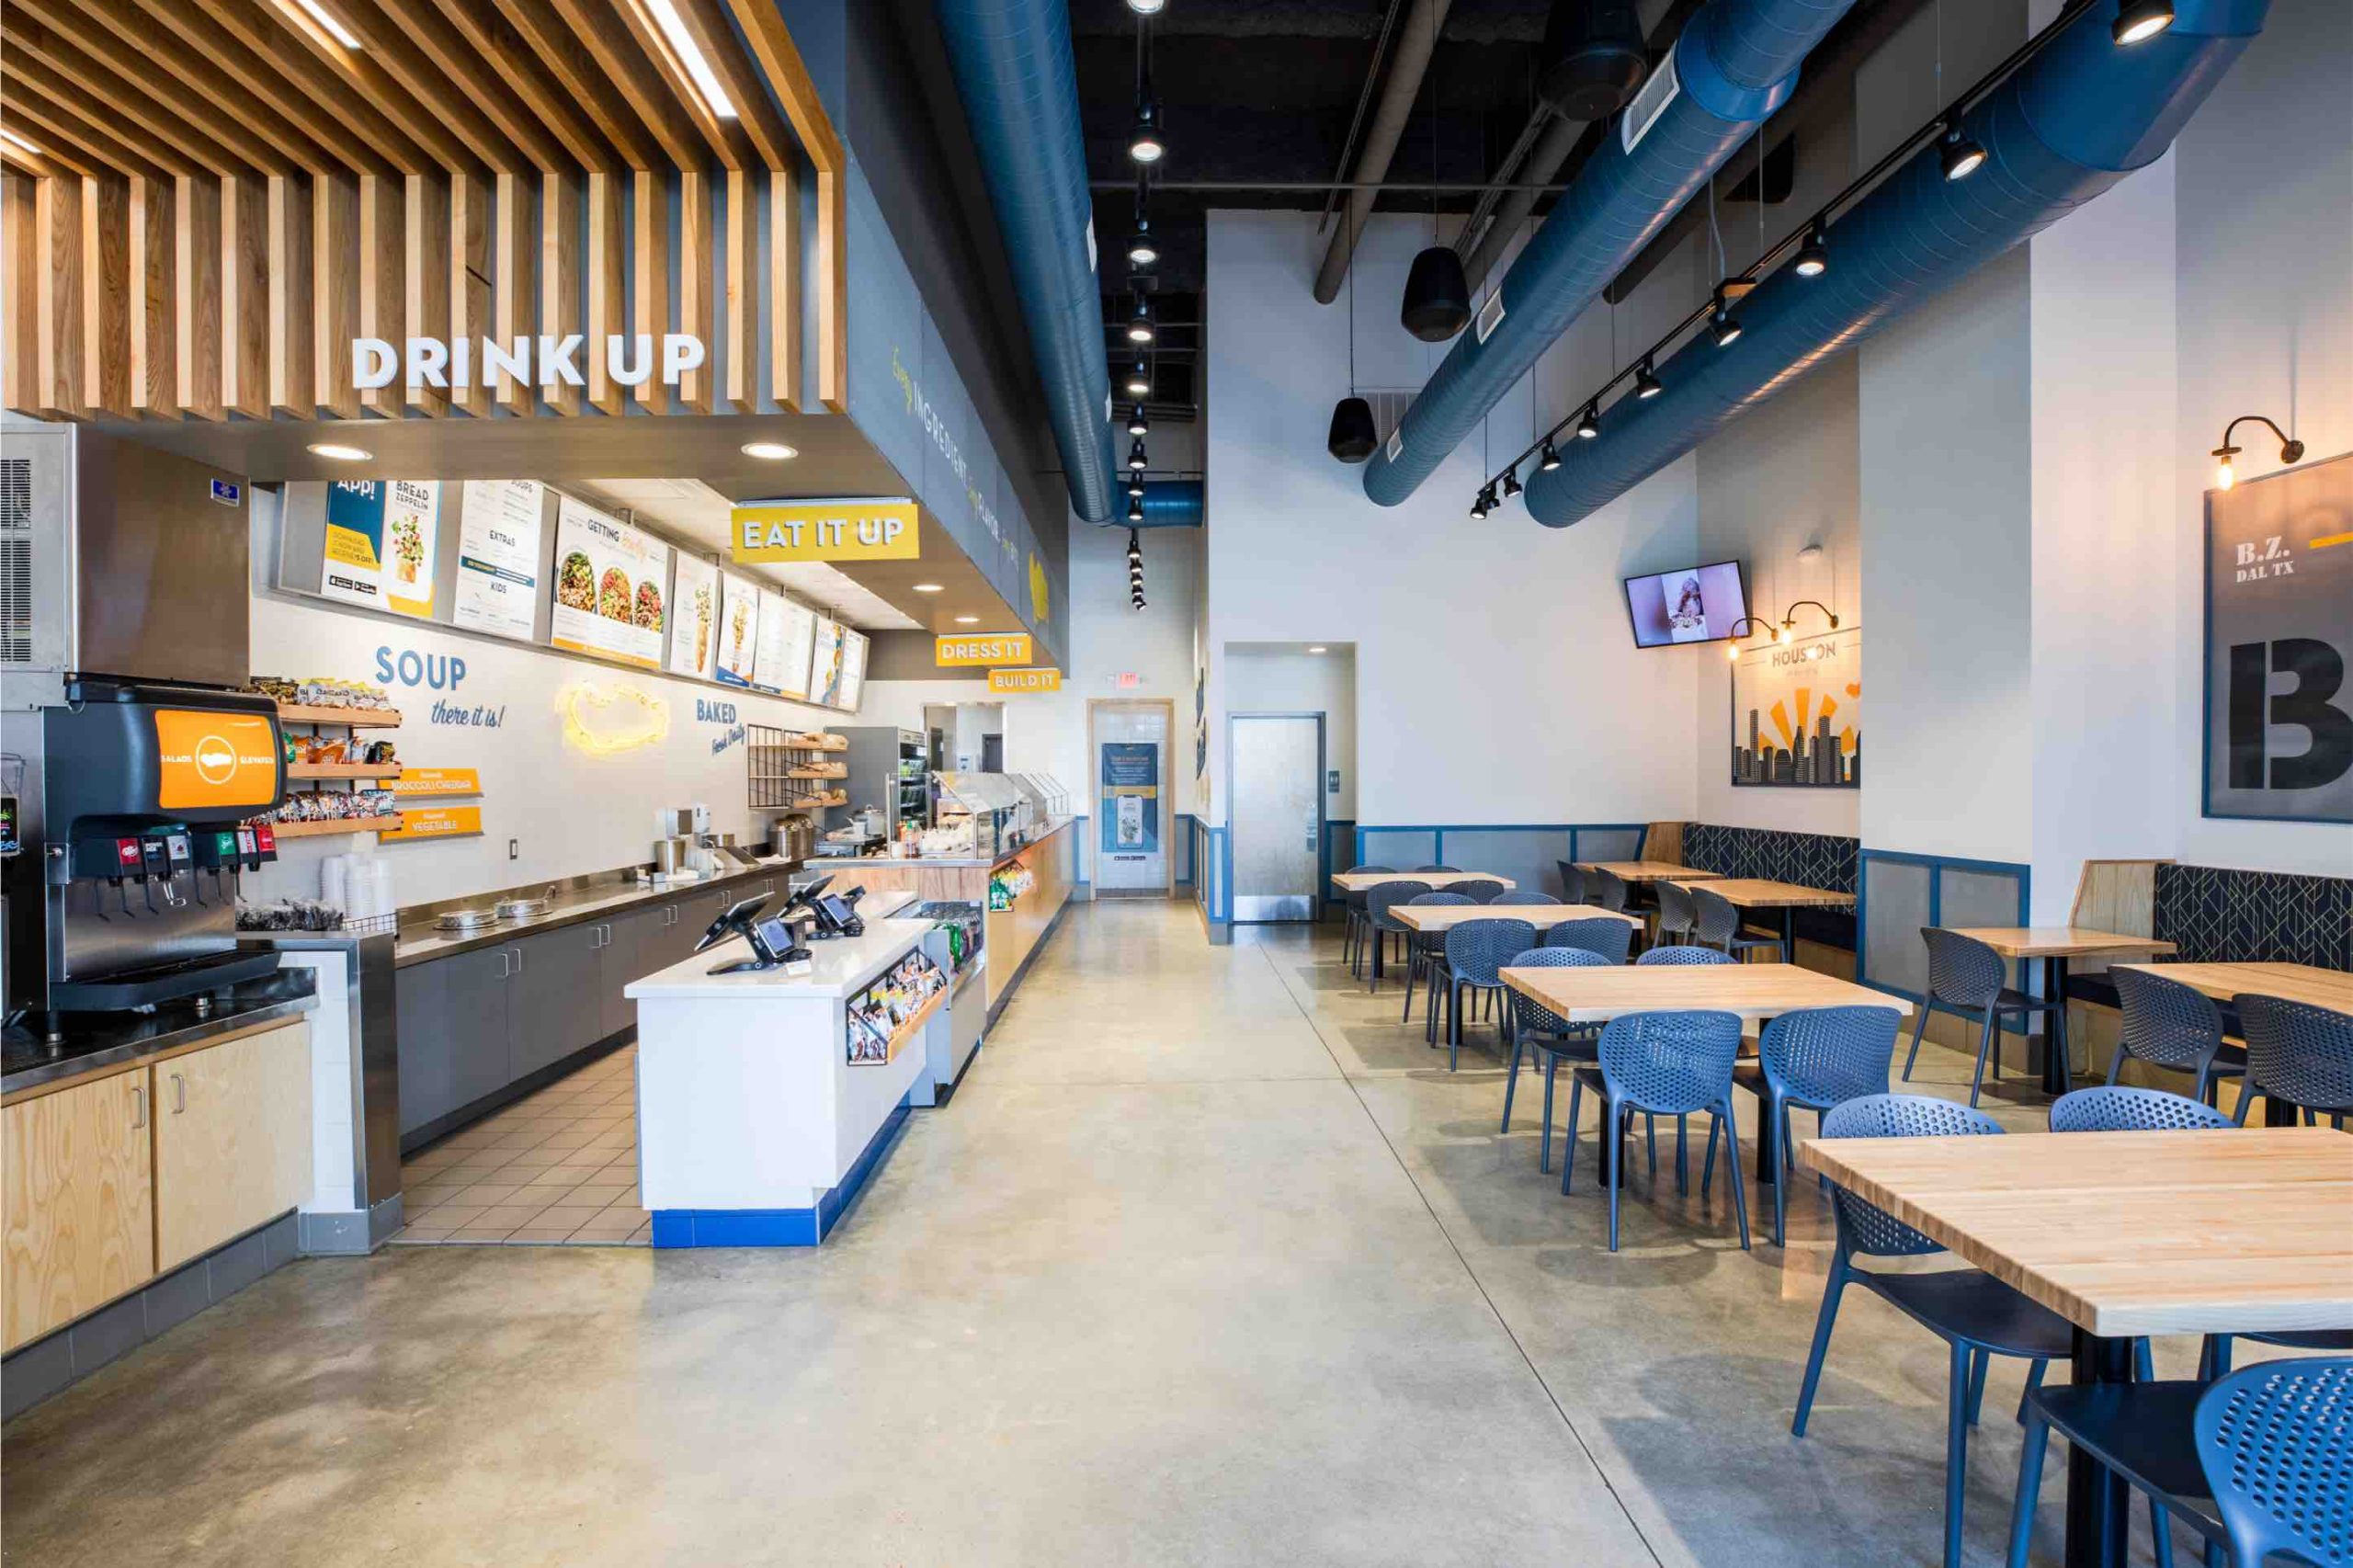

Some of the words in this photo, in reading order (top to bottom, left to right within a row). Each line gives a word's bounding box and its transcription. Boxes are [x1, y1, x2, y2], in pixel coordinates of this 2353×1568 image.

[352, 334, 586, 389] DRINK
[608, 334, 706, 386] UP
[395, 492, 429, 510] ZEPPELIN
[396, 480, 430, 501] BREAD
[489, 529, 517, 548] EXTRAS
[587, 519, 620, 542] GETTING
[743, 519, 805, 549] EAT
[816, 518, 849, 546] IT
[858, 517, 904, 546] UP
[2235, 535, 2291, 565] B.Z.
[2236, 566, 2268, 583] DAL
[2272, 561, 2295, 576] TX
[490, 581, 507, 595] KIDS
[942, 642, 1002, 659] DRESS
[1006, 642, 1023, 658] IT
[1771, 641, 1836, 668] HOUSON
[375, 645, 467, 691] SOUP
[995, 675, 1038, 688] BUILD
[1041, 674, 1053, 687] IT
[431, 699, 471, 725] there
[471, 702, 483, 726] it
[697, 699, 736, 724] BAKED
[2229, 638, 2353, 790] B
